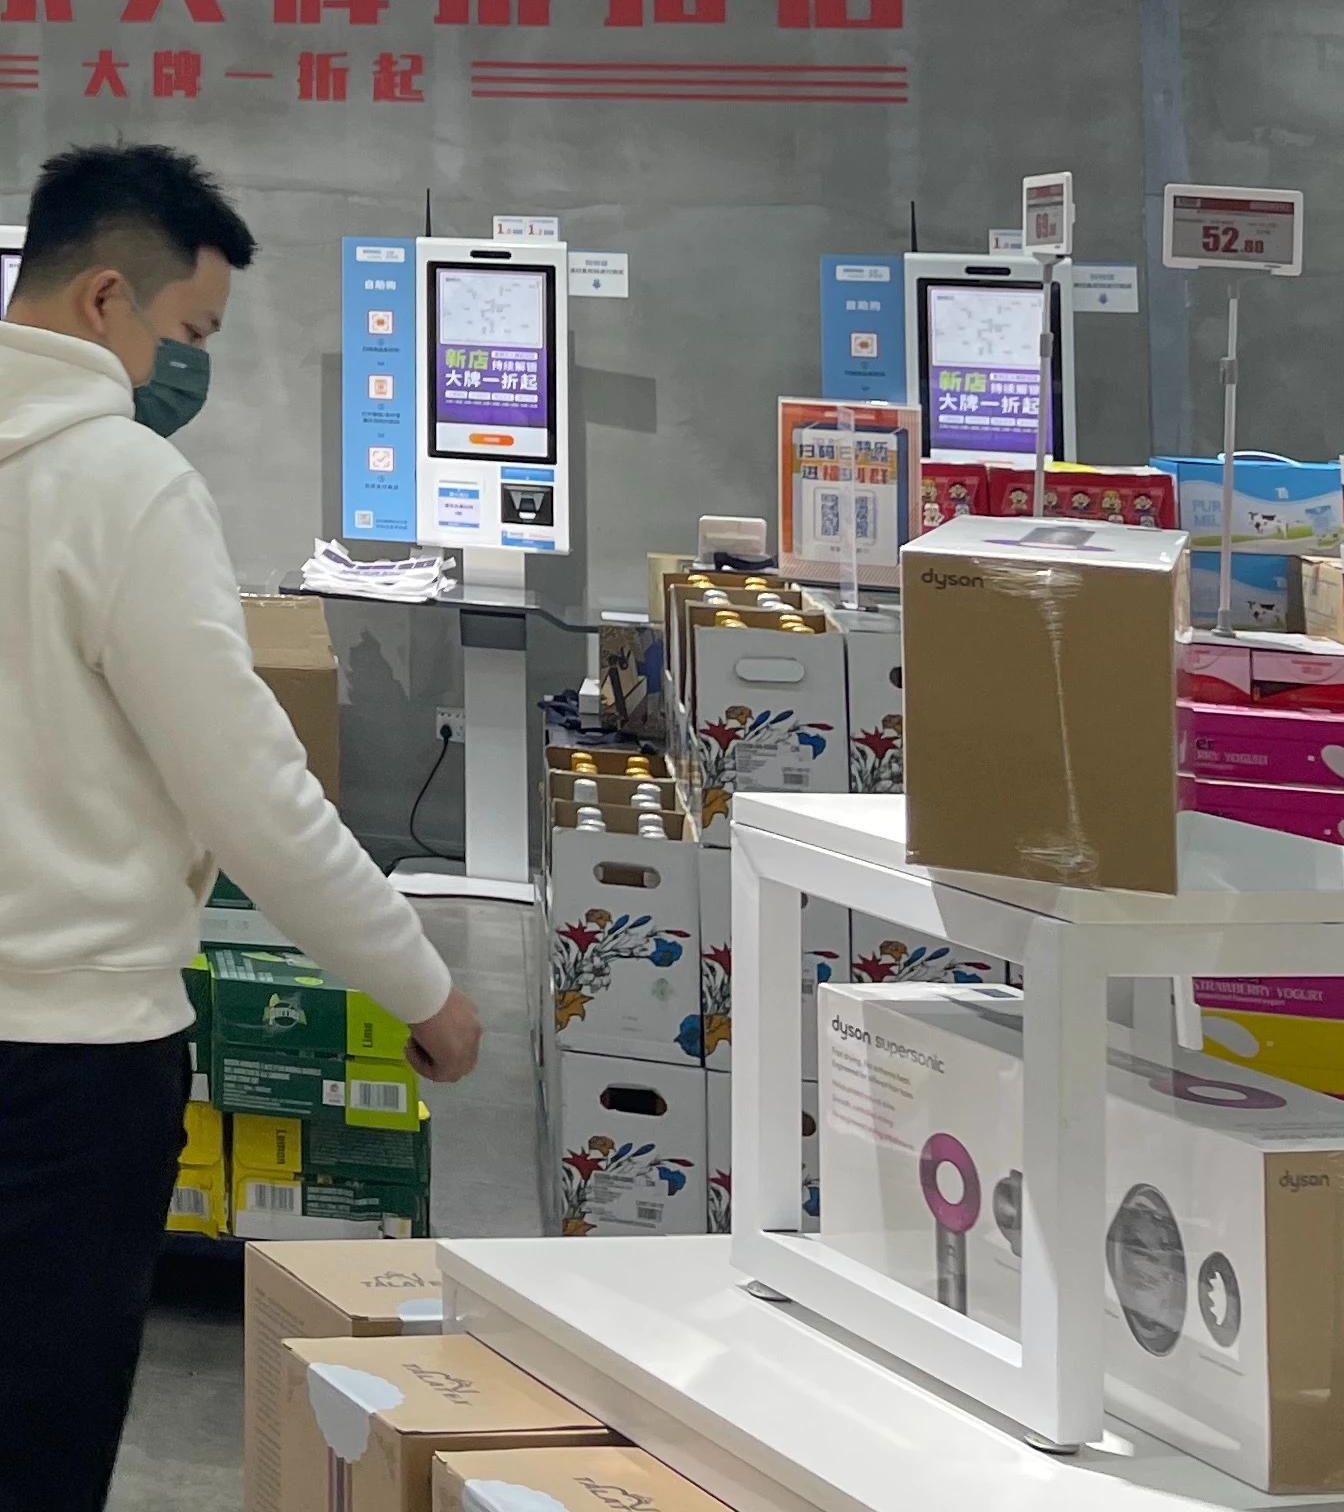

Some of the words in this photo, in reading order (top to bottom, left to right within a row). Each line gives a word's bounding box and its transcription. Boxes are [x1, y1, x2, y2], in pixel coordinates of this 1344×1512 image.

[82, 51, 427, 104] 大牌一折起
[445, 349, 489, 370] 新店
[445, 369, 538, 391] 大牌一折起
[938, 392, 1040, 416] 大牌一折起
[921, 568, 984, 590] dyson
[832, 1015, 872, 1045] dyson
[875, 1035, 945, 1075] supersonic
[1279, 1169, 1330, 1191] dyson
